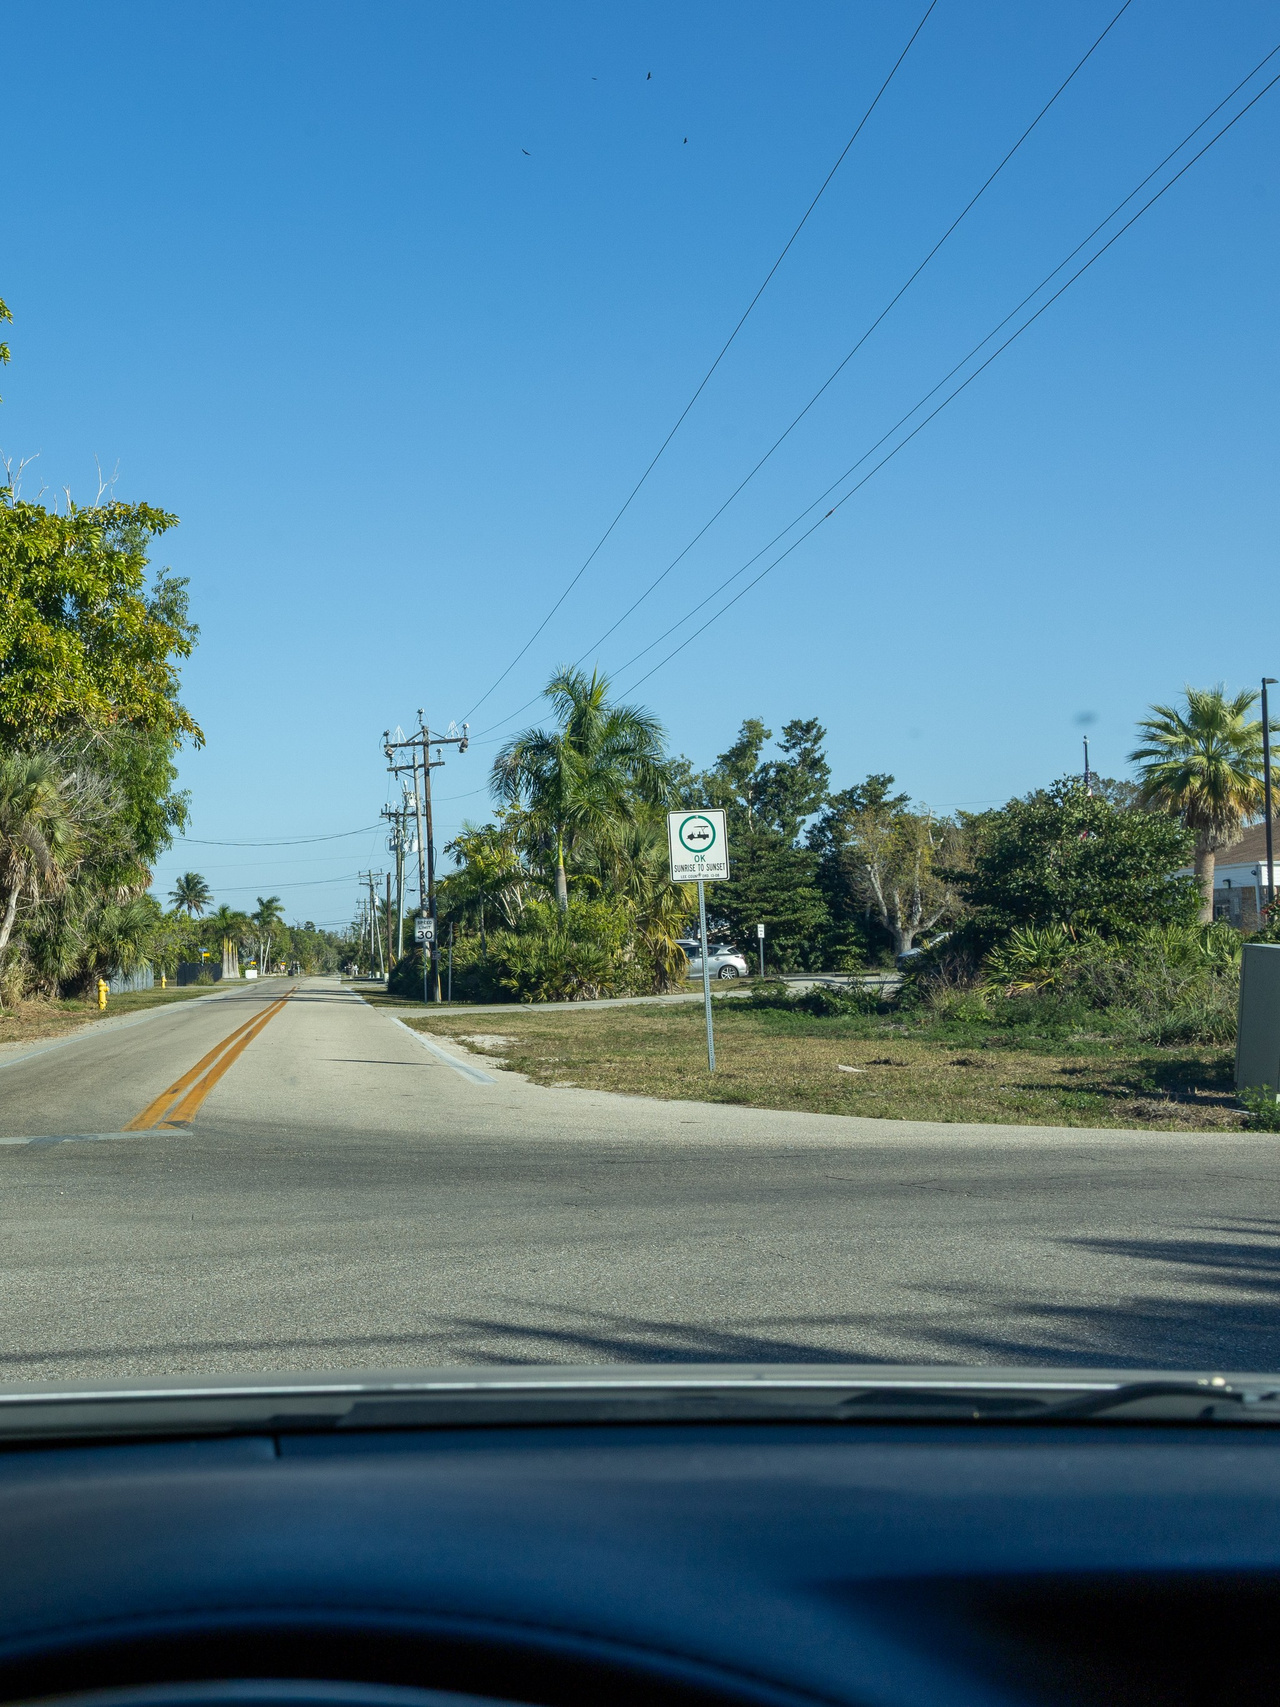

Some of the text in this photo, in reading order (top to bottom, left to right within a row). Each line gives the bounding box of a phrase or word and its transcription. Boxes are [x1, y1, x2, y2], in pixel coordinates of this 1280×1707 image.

[674, 863, 726, 872] SUNRISE TO SUNSET
[417, 930, 433, 939] 30
